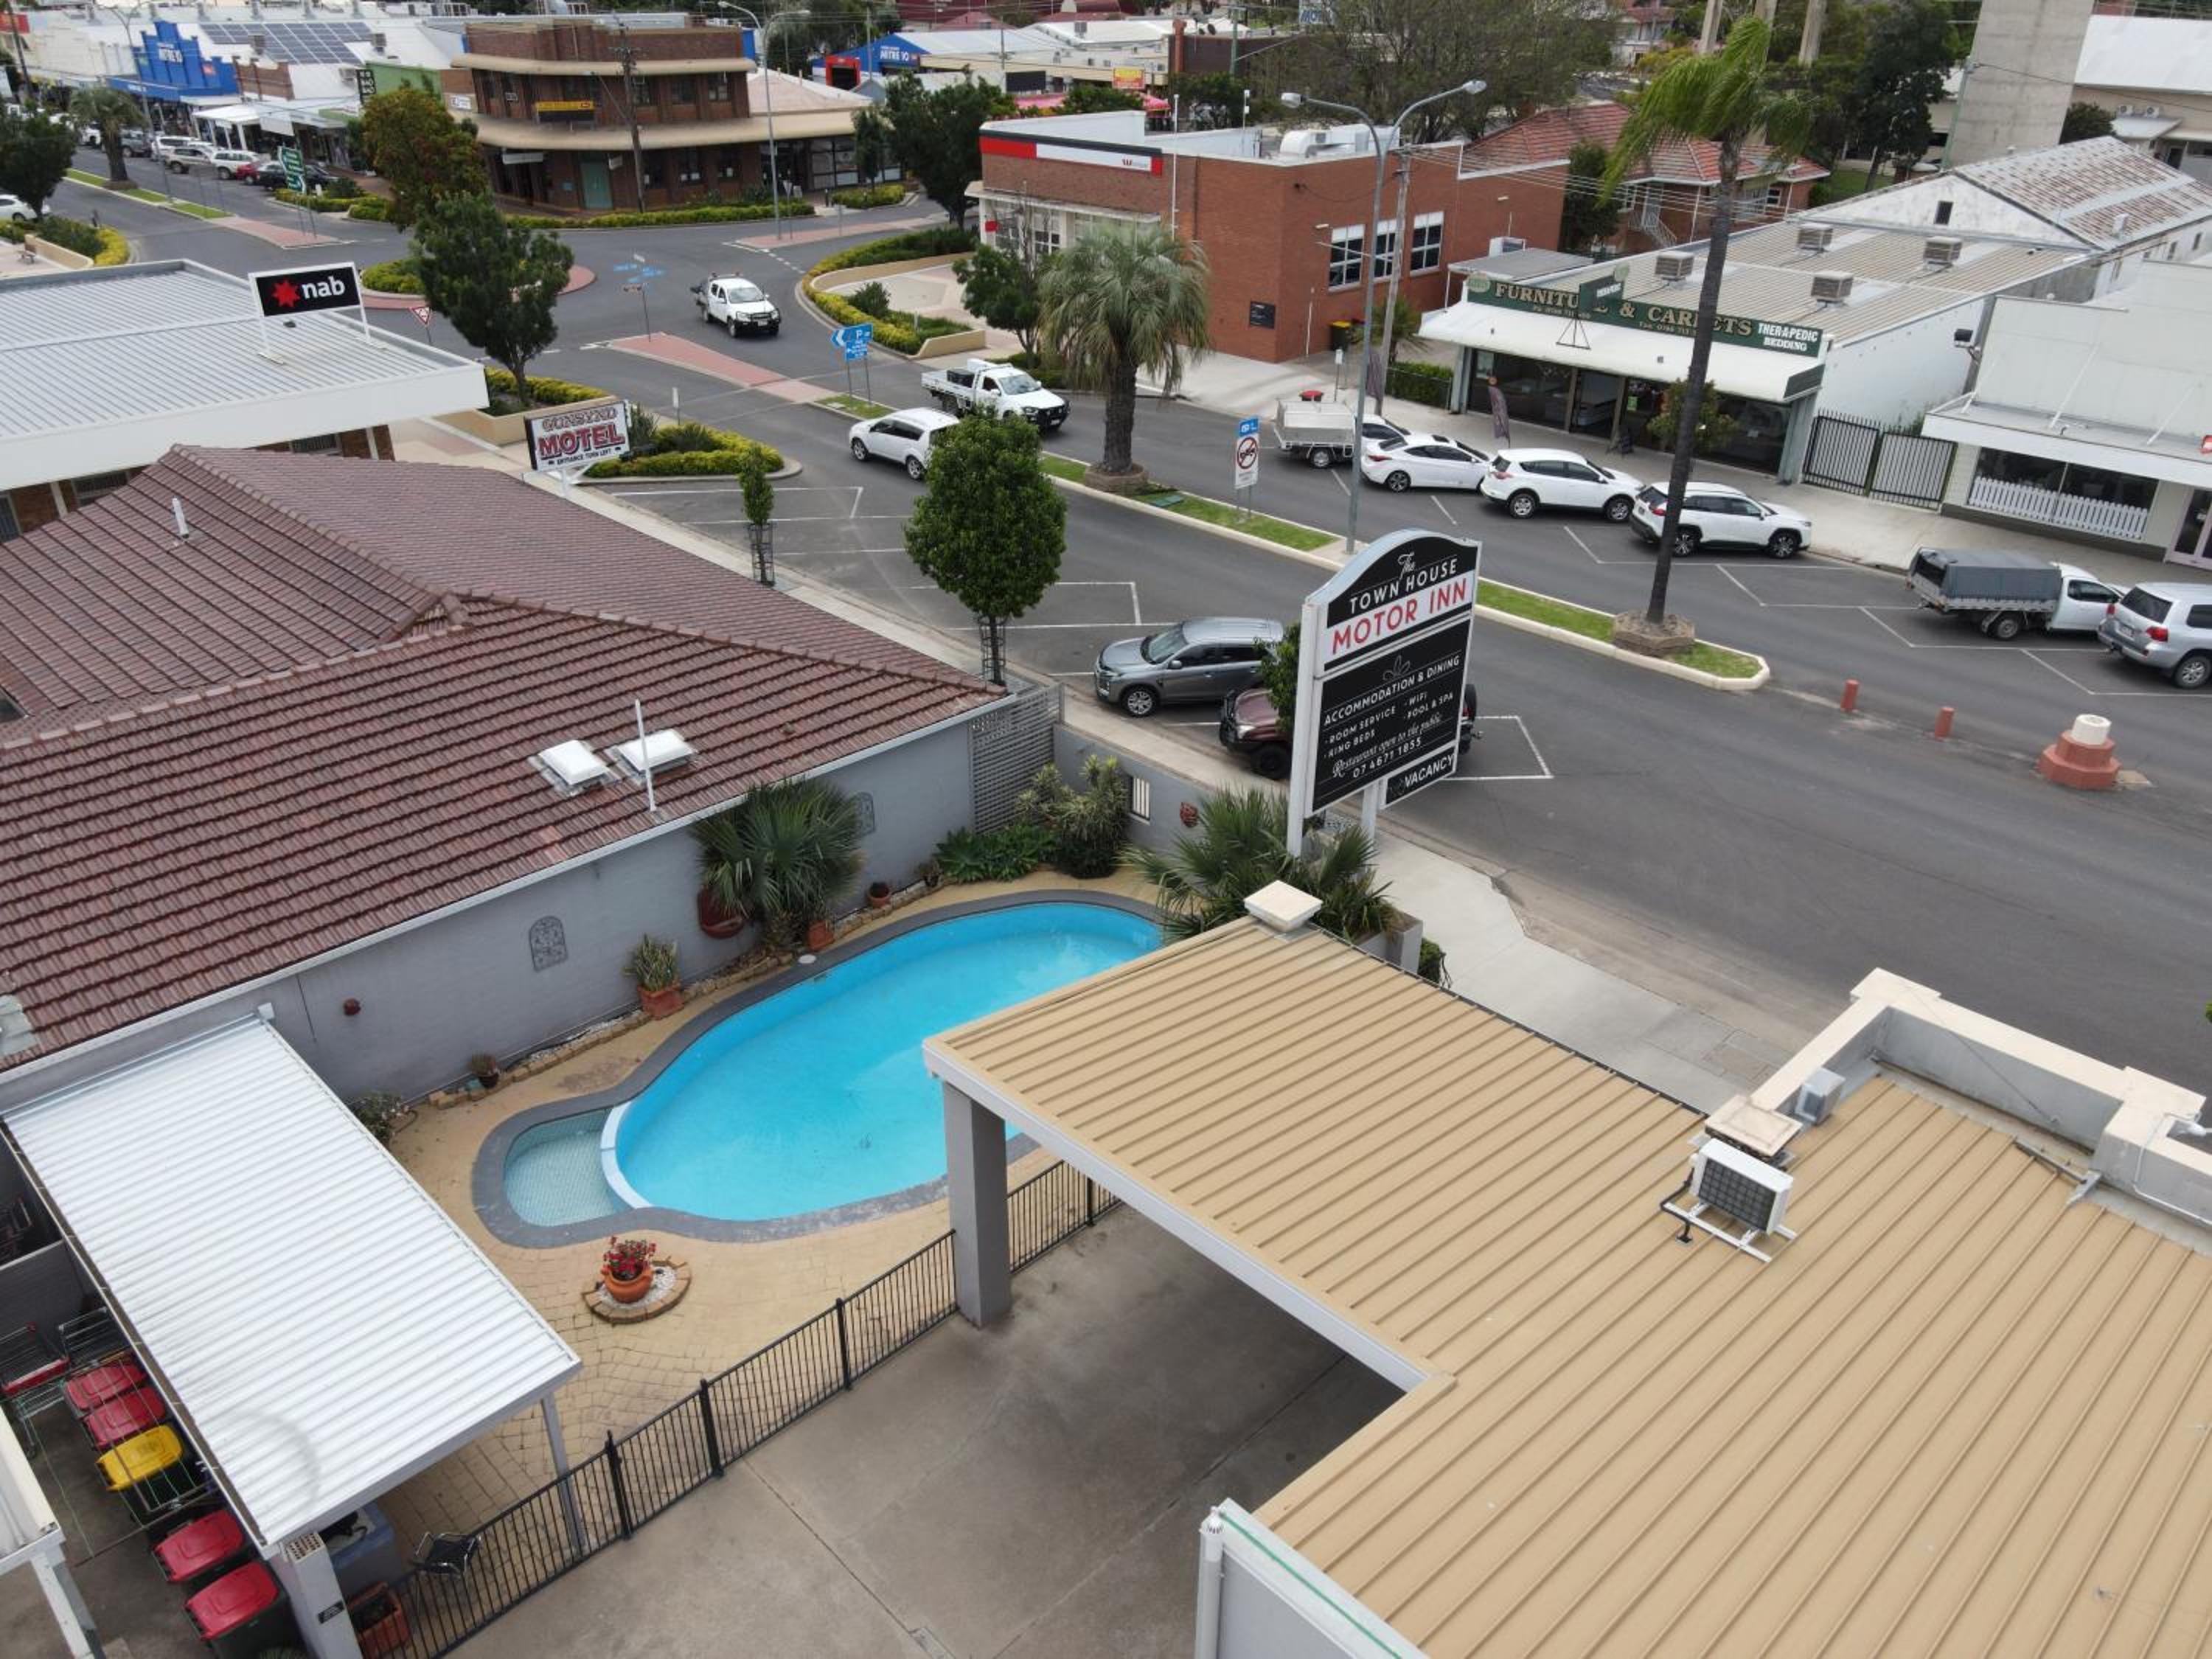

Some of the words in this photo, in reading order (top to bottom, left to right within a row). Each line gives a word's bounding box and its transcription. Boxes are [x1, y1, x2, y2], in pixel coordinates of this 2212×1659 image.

[302, 275, 346, 299] nab
[1619, 302, 1635, 319] &
[1763, 337, 1807, 352] BEDDING
[538, 424, 625, 460] MOTEL
[1398, 552, 1416, 580] The
[1350, 581, 1399, 614] TOWN
[1405, 558, 1458, 593] HOUSE
[1332, 598, 1418, 655] MOTOR
[1429, 577, 1467, 614] INN
[1324, 676, 1415, 726] ACCOMMODATION
[1417, 672, 1424, 683] &
[1427, 655, 1460, 679] DINING
[1407, 703, 1429, 719] POOL
[1439, 692, 1453, 705] SPA
[1409, 691, 1428, 706] WIFI
[1329, 725, 1357, 744] ROOM
[1360, 706, 1396, 730] SERVICE
[1329, 740, 1352, 758] KING
[1353, 728, 1376, 746] BEDS
[1353, 764, 1366, 778] 07
[1369, 750, 1394, 769] 4671
[1399, 737, 1422, 756] 1855
[1404, 754, 1454, 787] VACANCY
